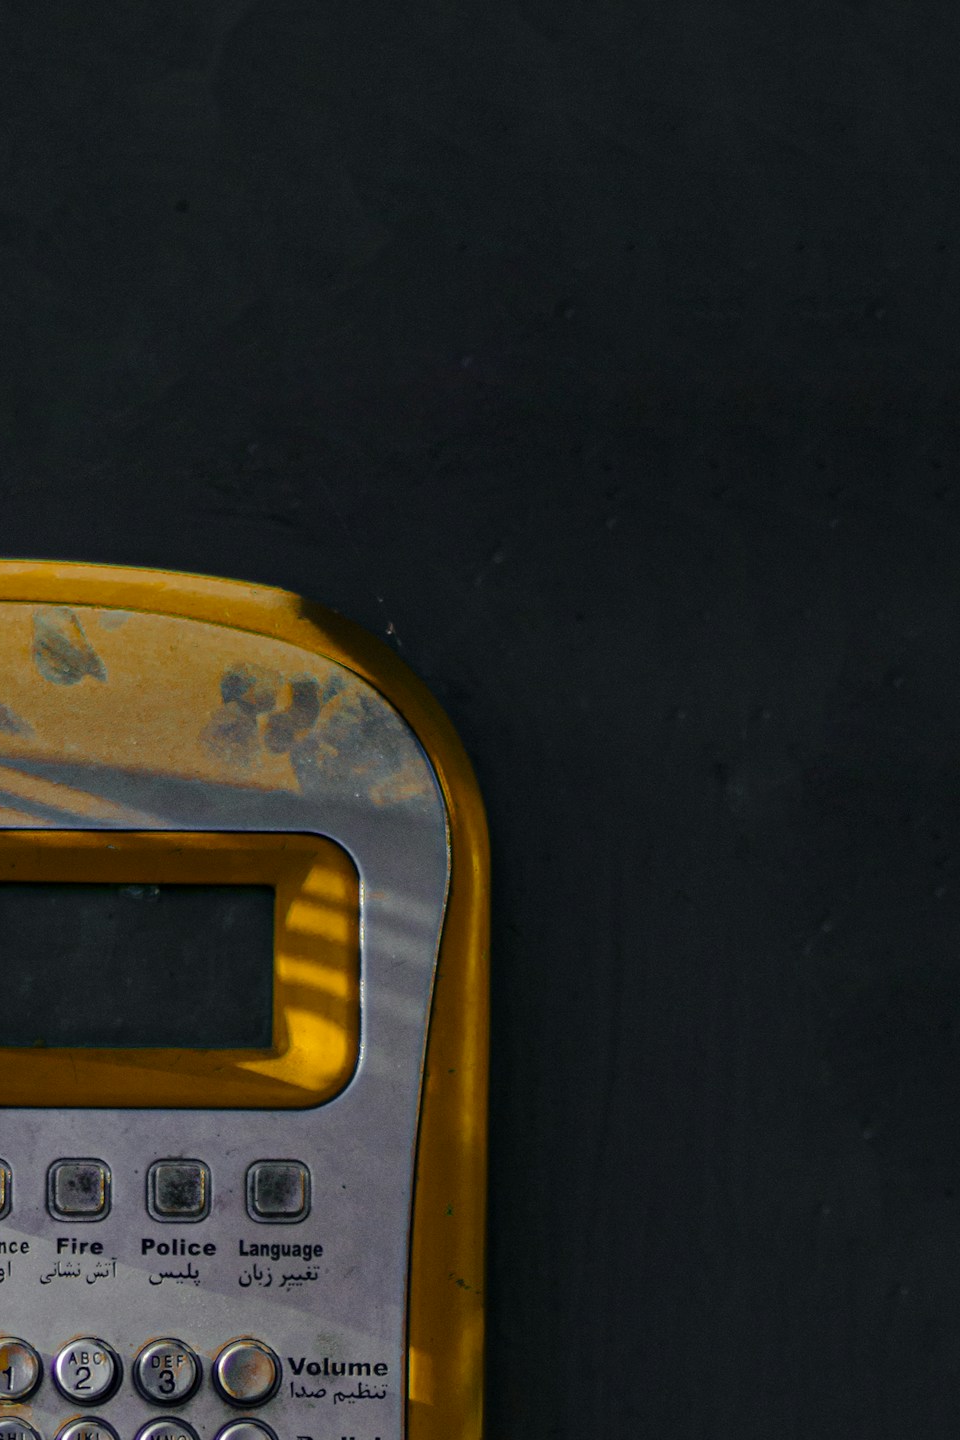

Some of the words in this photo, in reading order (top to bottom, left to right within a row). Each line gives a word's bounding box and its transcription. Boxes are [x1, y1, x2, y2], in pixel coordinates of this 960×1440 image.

[56, 1238, 104, 1256] Fire
[141, 1238, 217, 1257] Police
[239, 1239, 324, 1262] Language
[40, 1260, 81, 1284] نشانی
[86, 1257, 118, 1284] آتش
[149, 1262, 201, 1287] پلیس
[239, 1264, 272, 1287] زبان
[279, 1265, 321, 1289] تغییر
[1, 1366, 14, 1390] 1
[288, 1357, 389, 1376] Volume
[75, 1366, 92, 1391] 2
[158, 1369, 176, 1395] 3
[290, 1381, 326, 1399] صدا
[333, 1382, 389, 1405] تنظیم
